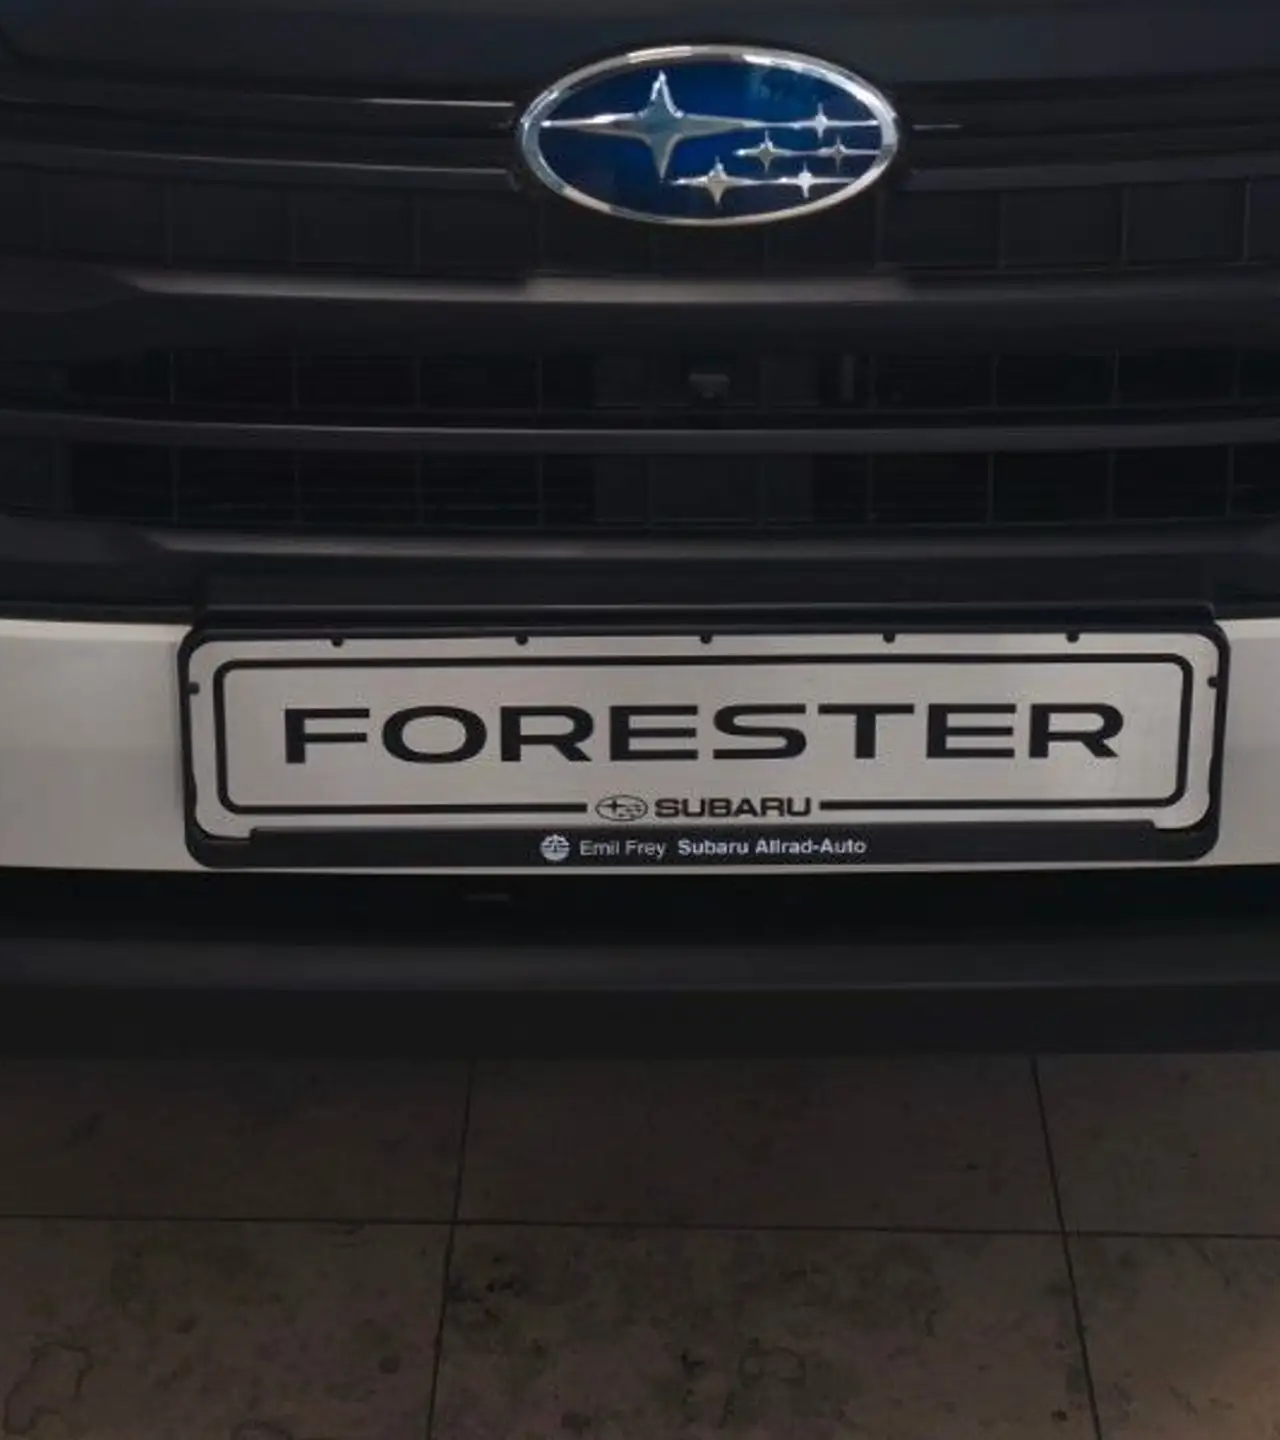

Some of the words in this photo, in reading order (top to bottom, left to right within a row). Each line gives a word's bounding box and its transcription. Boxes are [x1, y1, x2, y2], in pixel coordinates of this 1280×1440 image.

[285, 703, 1124, 765] FORESTER
[654, 797, 812, 818] SUBARU
[579, 839, 620, 856] Emil
[625, 839, 667, 859] Frey
[677, 838, 749, 855] Subaru
[755, 837, 868, 855] Allrad-Auto
